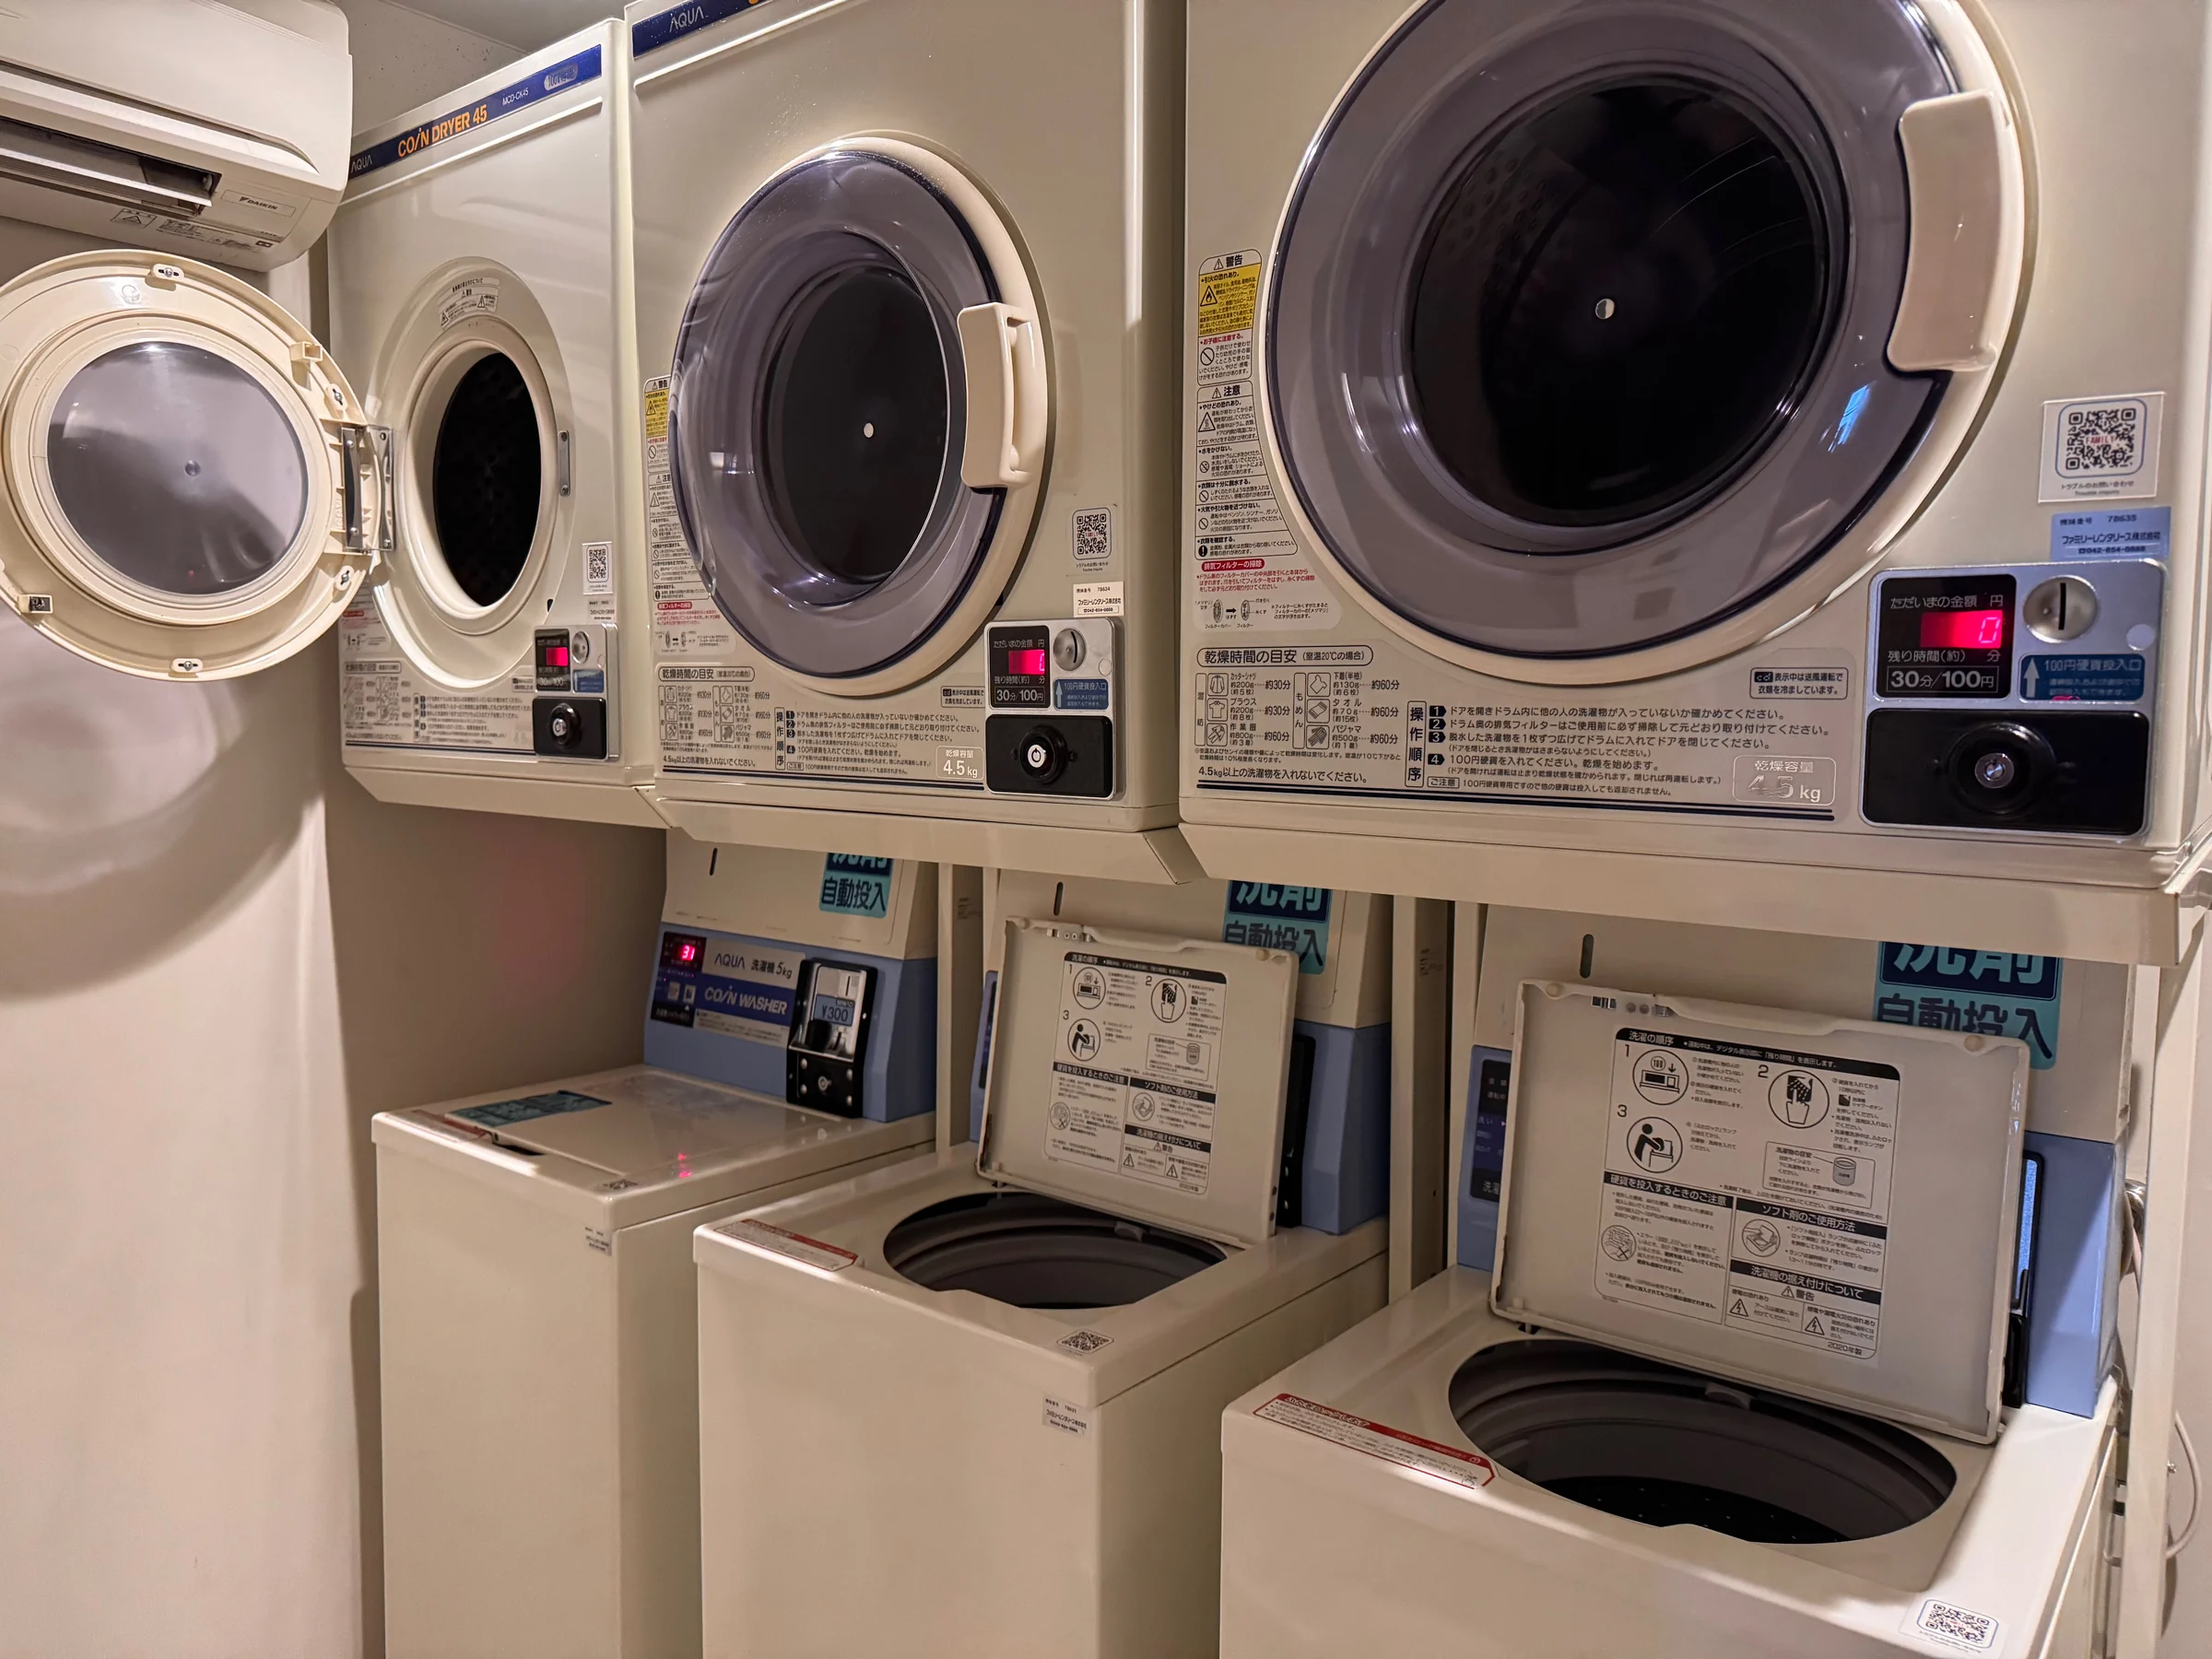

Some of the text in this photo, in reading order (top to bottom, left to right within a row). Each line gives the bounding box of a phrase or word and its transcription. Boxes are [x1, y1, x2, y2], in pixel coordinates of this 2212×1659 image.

[669, 6, 704, 33] AQUA
[397, 103, 488, 158] COIN DRYER 45
[350, 155, 373, 173] AQUA
[247, 198, 278, 210] DAIKIN
[1226, 253, 1243, 268] 警告
[1223, 384, 1241, 396] 注意
[1204, 559, 1263, 571] 排気フィルターの掃除
[1889, 594, 2005, 609] ただいまの金額 円
[1978, 616, 2002, 644] 0
[1204, 649, 1298, 665] 乾燥時間の目安
[1887, 649, 2002, 664] 残り時間(約) 分
[1265, 679, 1291, 690] 約30分
[1371, 679, 1400, 690] 約60分
[1774, 672, 1843, 683] 表示中は送風運転で
[1889, 669, 1994, 689] 30分/100円
[1758, 685, 1840, 696] 衣類を冷ましています。
[1264, 705, 1290, 716] 約30分
[1370, 706, 1399, 718] 約60分
[1449, 706, 1784, 720] ドアを開きドラム内に他の人の洗濯物が入っていないか確かめてください。
[1449, 719, 1830, 736] ドラム奥の排気フィルターはご使用前に必ず掃除して元どおり取り付けてください。
[1264, 731, 1290, 742] 約60分
[1370, 734, 1398, 745] 約60分
[1407, 706, 1424, 782] 操作順序
[1449, 732, 1770, 749] 脱水した洗濯物を1枚ずつ広げてドラムに入れてドアを閉じてください。
[943, 759, 978, 779] 4.5 kg
[1198, 766, 1368, 783] 4.5kg以上の洗濯物を入れないでください。
[1799, 784, 1821, 803] kg
[820, 877, 888, 913] 自動投入
[714, 953, 746, 971] AQUA
[1145, 975, 1153, 986] 2
[703, 984, 788, 1016] COIN WASHER
[821, 1005, 849, 1023] ¥300
[1063, 1009, 1070, 1020] 3
[1629, 1030, 1675, 1046] 洗濯の順序
[1623, 1043, 1630, 1058] 1
[1757, 1064, 1770, 1079] 2
[1617, 1104, 1628, 1118] 3
[1609, 1173, 1727, 1206] 硬貨を投入するときのご注意
[1761, 1204, 1856, 1232] ソフト剤のご使用方法
